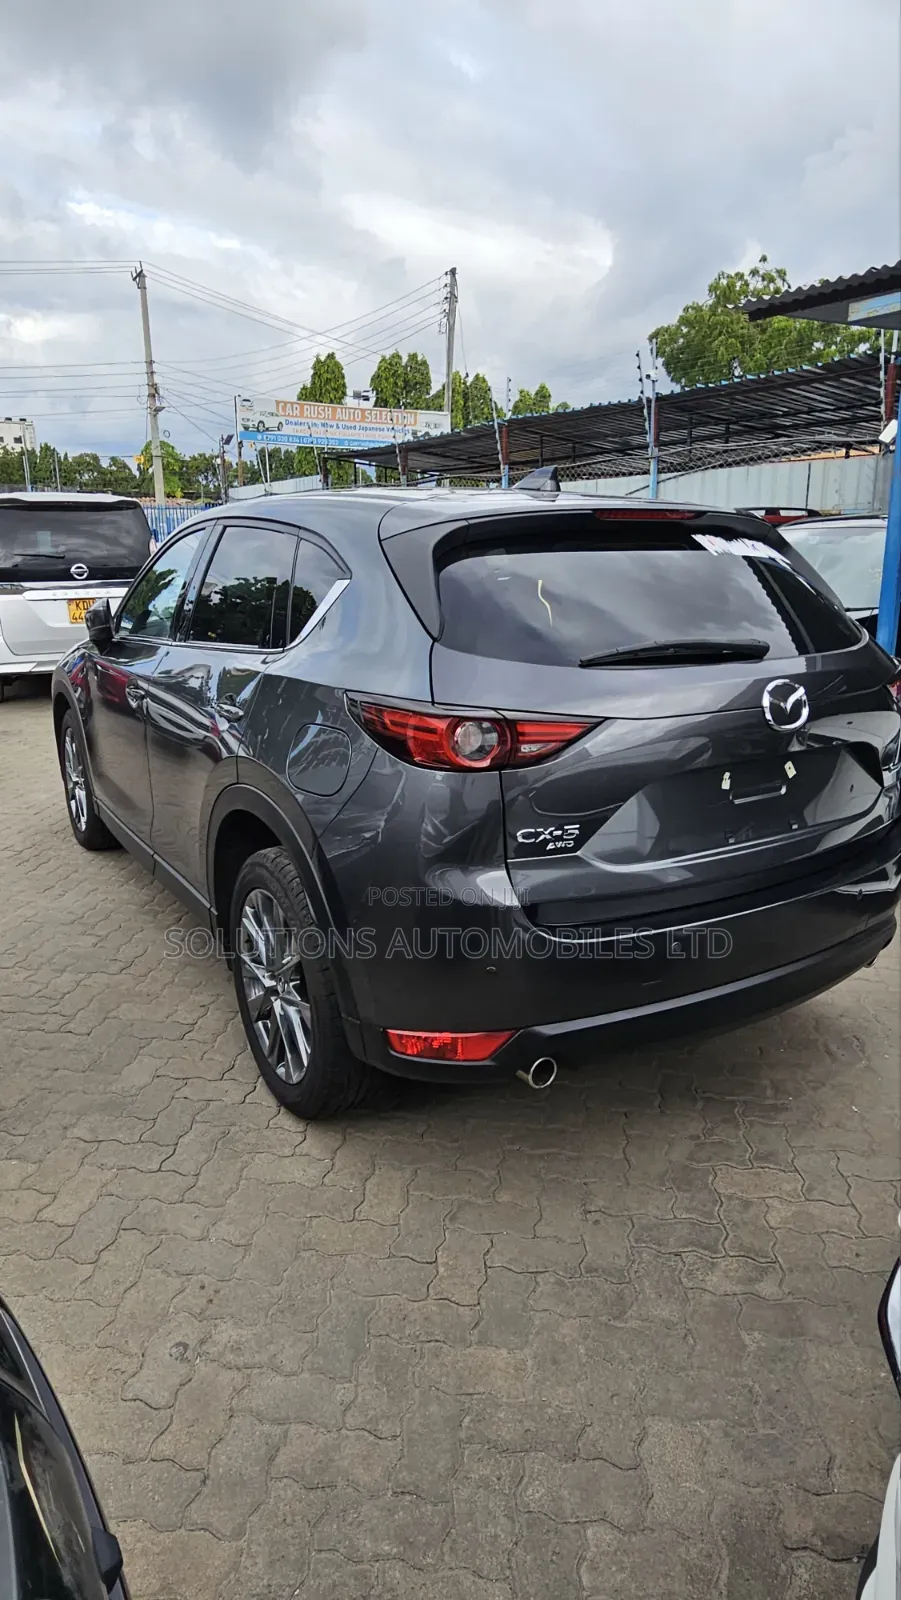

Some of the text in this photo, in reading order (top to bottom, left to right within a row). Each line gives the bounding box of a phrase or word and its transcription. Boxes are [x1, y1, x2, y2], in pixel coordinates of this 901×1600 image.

[278, 402, 415, 425] CAR RUSH AUTO SELECTION
[284, 419, 309, 428] Dealers
[341, 423, 358, 431] Used
[358, 424, 385, 433] Japanese
[386, 426, 410, 434] Vehicles
[71, 611, 84, 621] 44
[516, 824, 580, 843] CX-5
[546, 840, 575, 850] AWD
